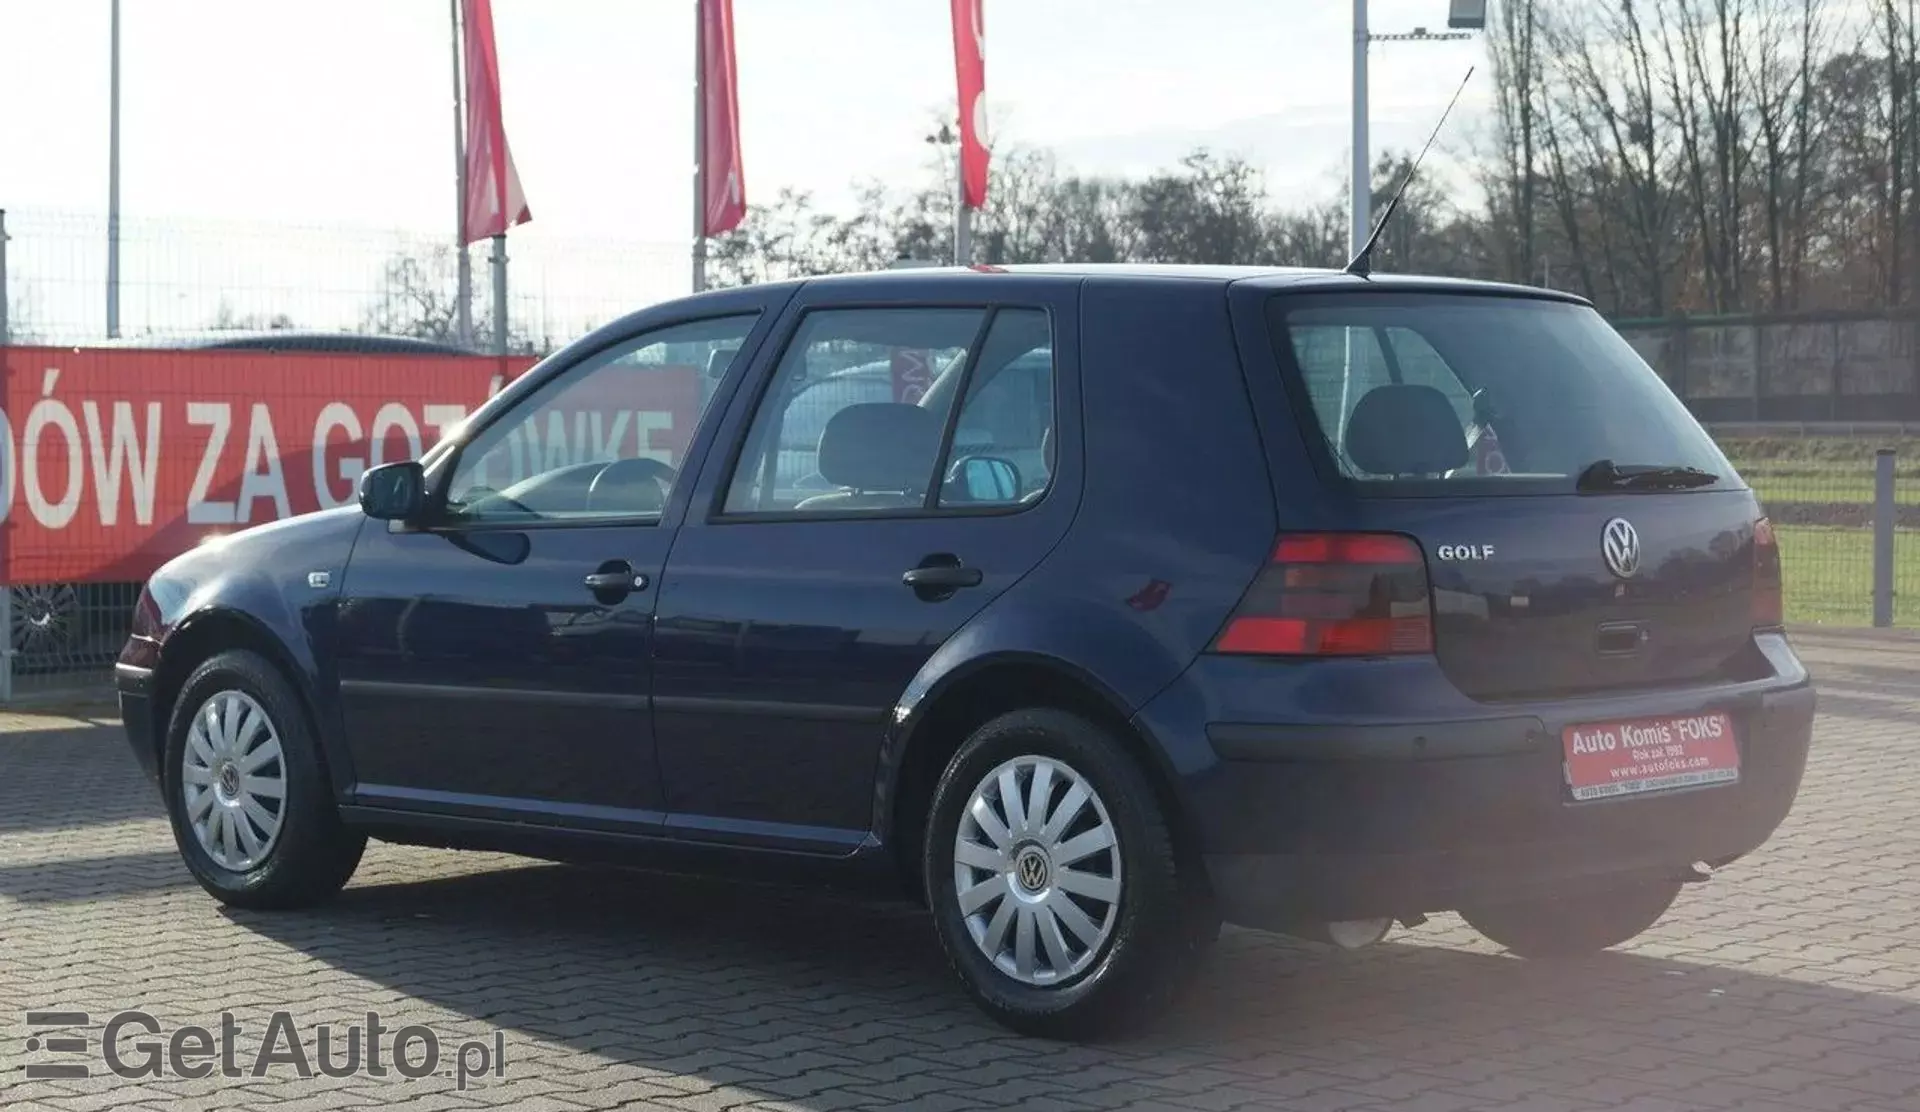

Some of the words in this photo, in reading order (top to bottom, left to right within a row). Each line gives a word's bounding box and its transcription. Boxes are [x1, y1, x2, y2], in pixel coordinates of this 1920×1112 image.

[186, 402, 292, 524] ZA
[1437, 544, 1496, 561] GOLF
[1573, 729, 1616, 754] Auto
[1620, 722, 1672, 748] Komis
